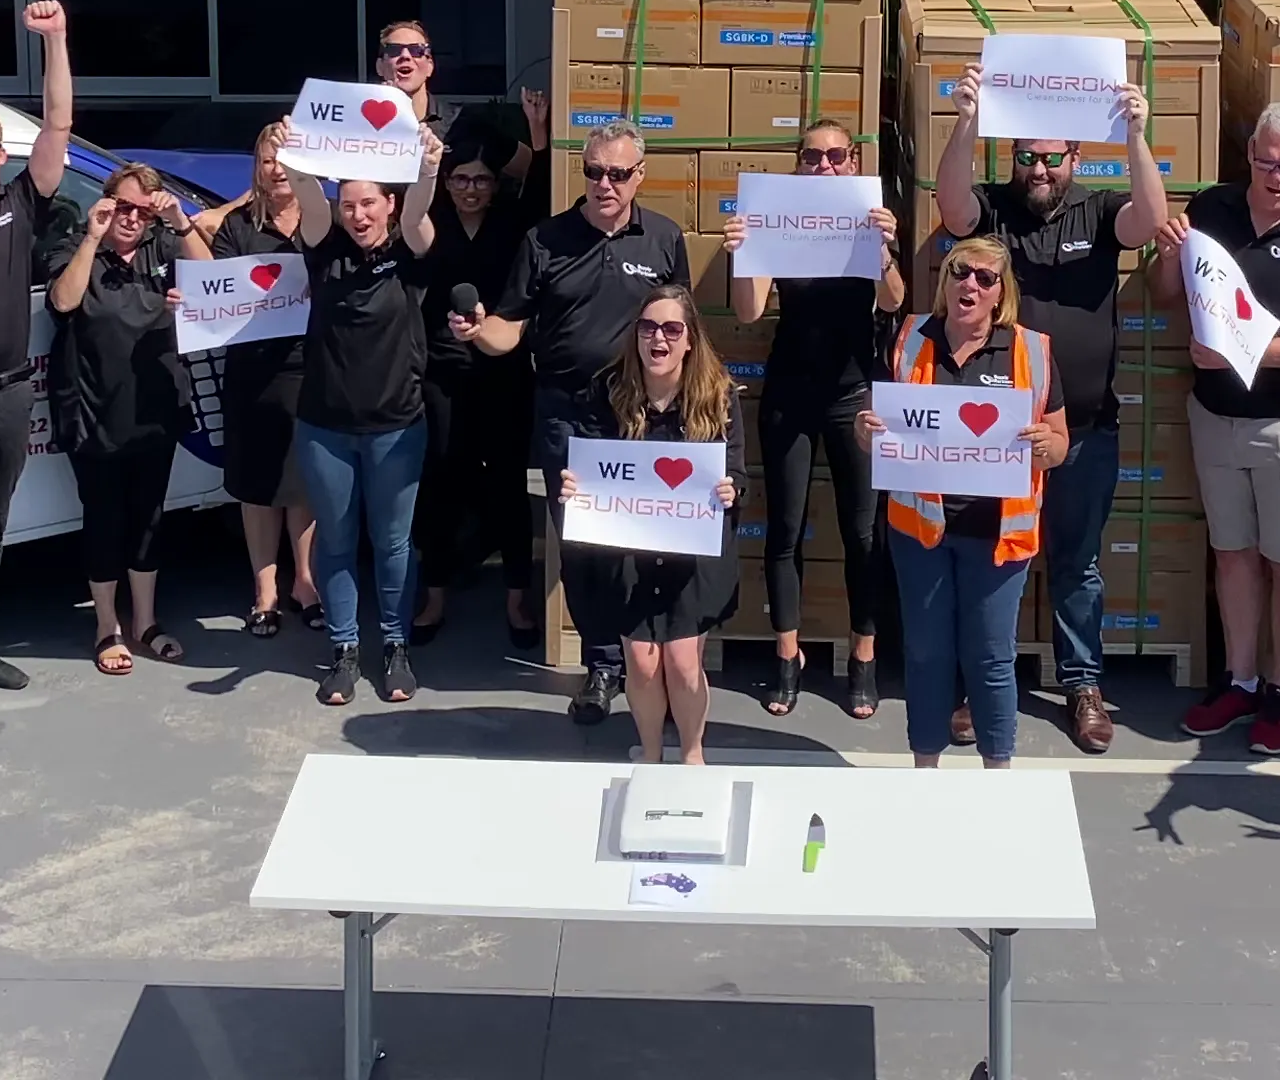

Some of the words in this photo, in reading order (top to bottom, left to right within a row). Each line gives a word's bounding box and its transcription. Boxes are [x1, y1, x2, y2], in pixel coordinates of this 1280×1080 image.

[725, 32, 768, 43] SG8K-D
[992, 73, 1119, 92] SUNGROW
[1057, 94, 1085, 104] power
[311, 102, 344, 122] WE
[286, 133, 417, 157] SUNGROW
[747, 214, 871, 230] SUNGROW
[812, 234, 841, 242] power
[202, 278, 235, 296] WE
[182, 295, 304, 322] SUNGROW
[903, 408, 940, 429] WE
[880, 442, 1023, 464] SUNGROW
[598, 462, 636, 481] WE
[573, 493, 716, 520] SUNGROW
